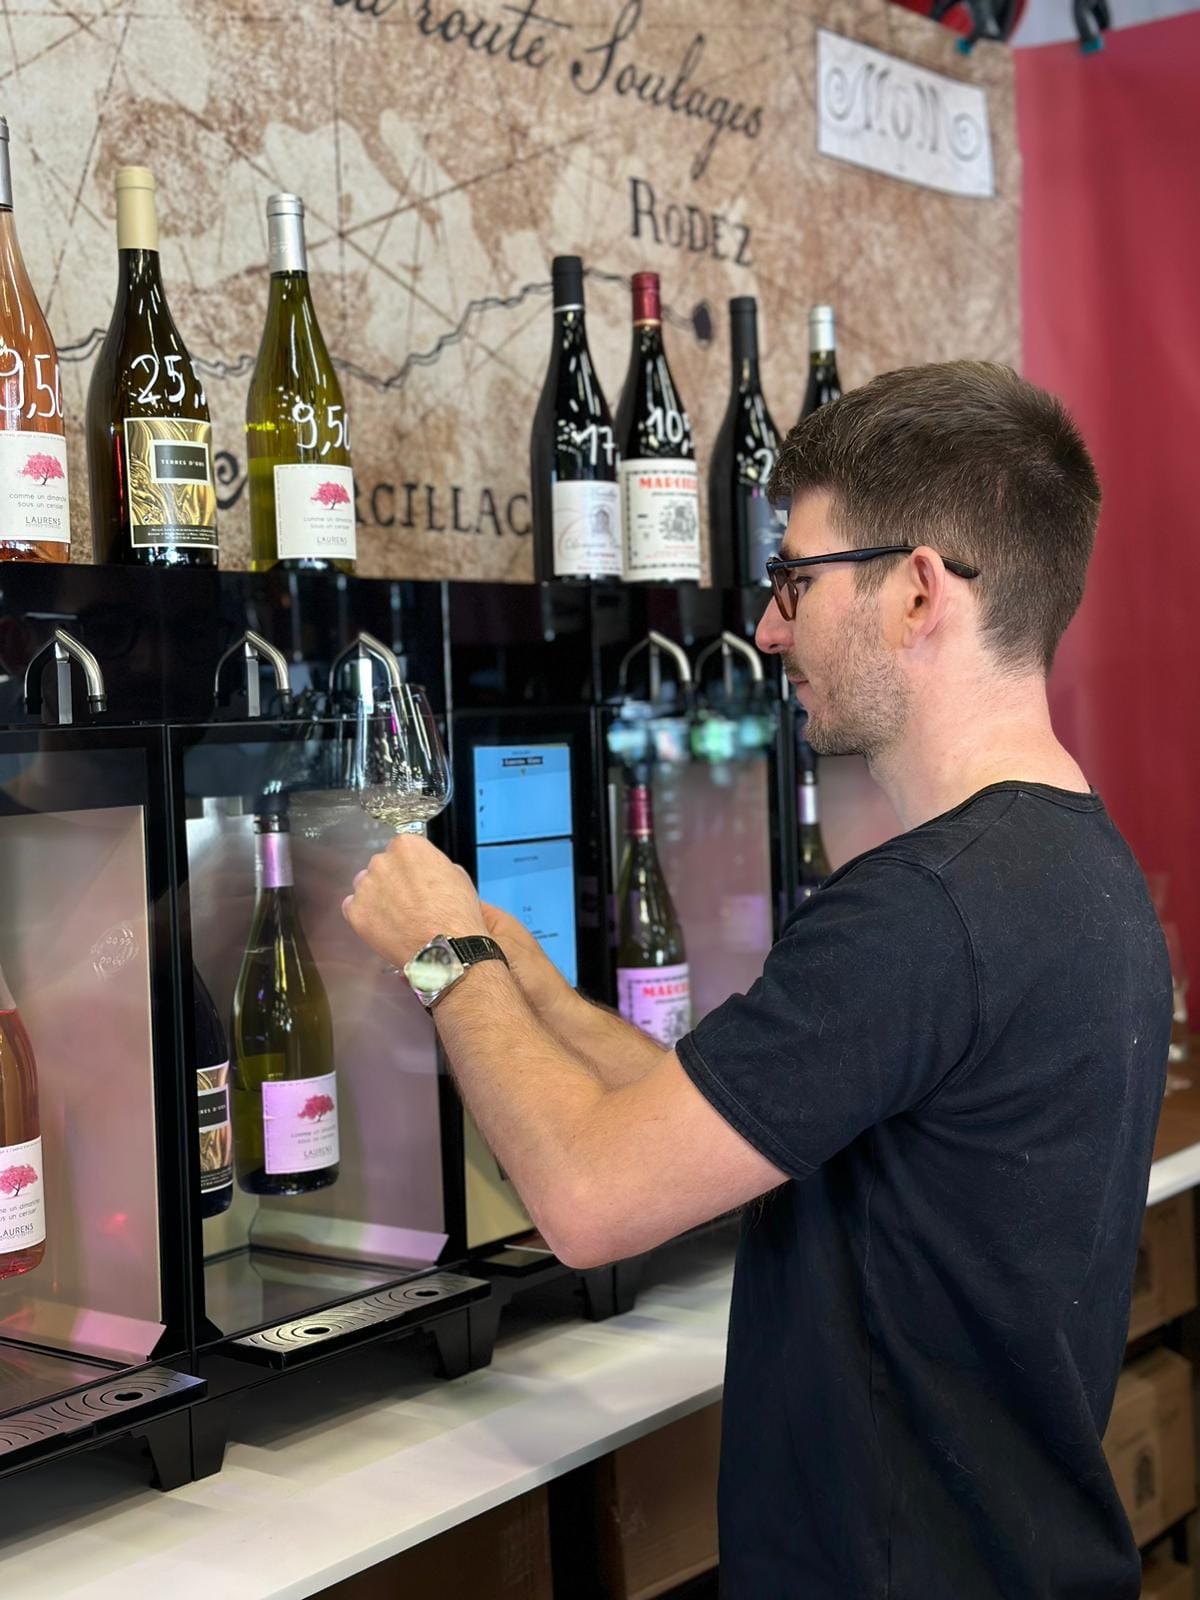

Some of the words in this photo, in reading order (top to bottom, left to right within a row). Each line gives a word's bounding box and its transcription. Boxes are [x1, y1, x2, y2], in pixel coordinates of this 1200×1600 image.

[413, 1, 571, 68] route
[570, 0, 764, 180] Soulages
[25, 515, 62, 526] LAURENS
[0, 1222, 34, 1238] AURENS
